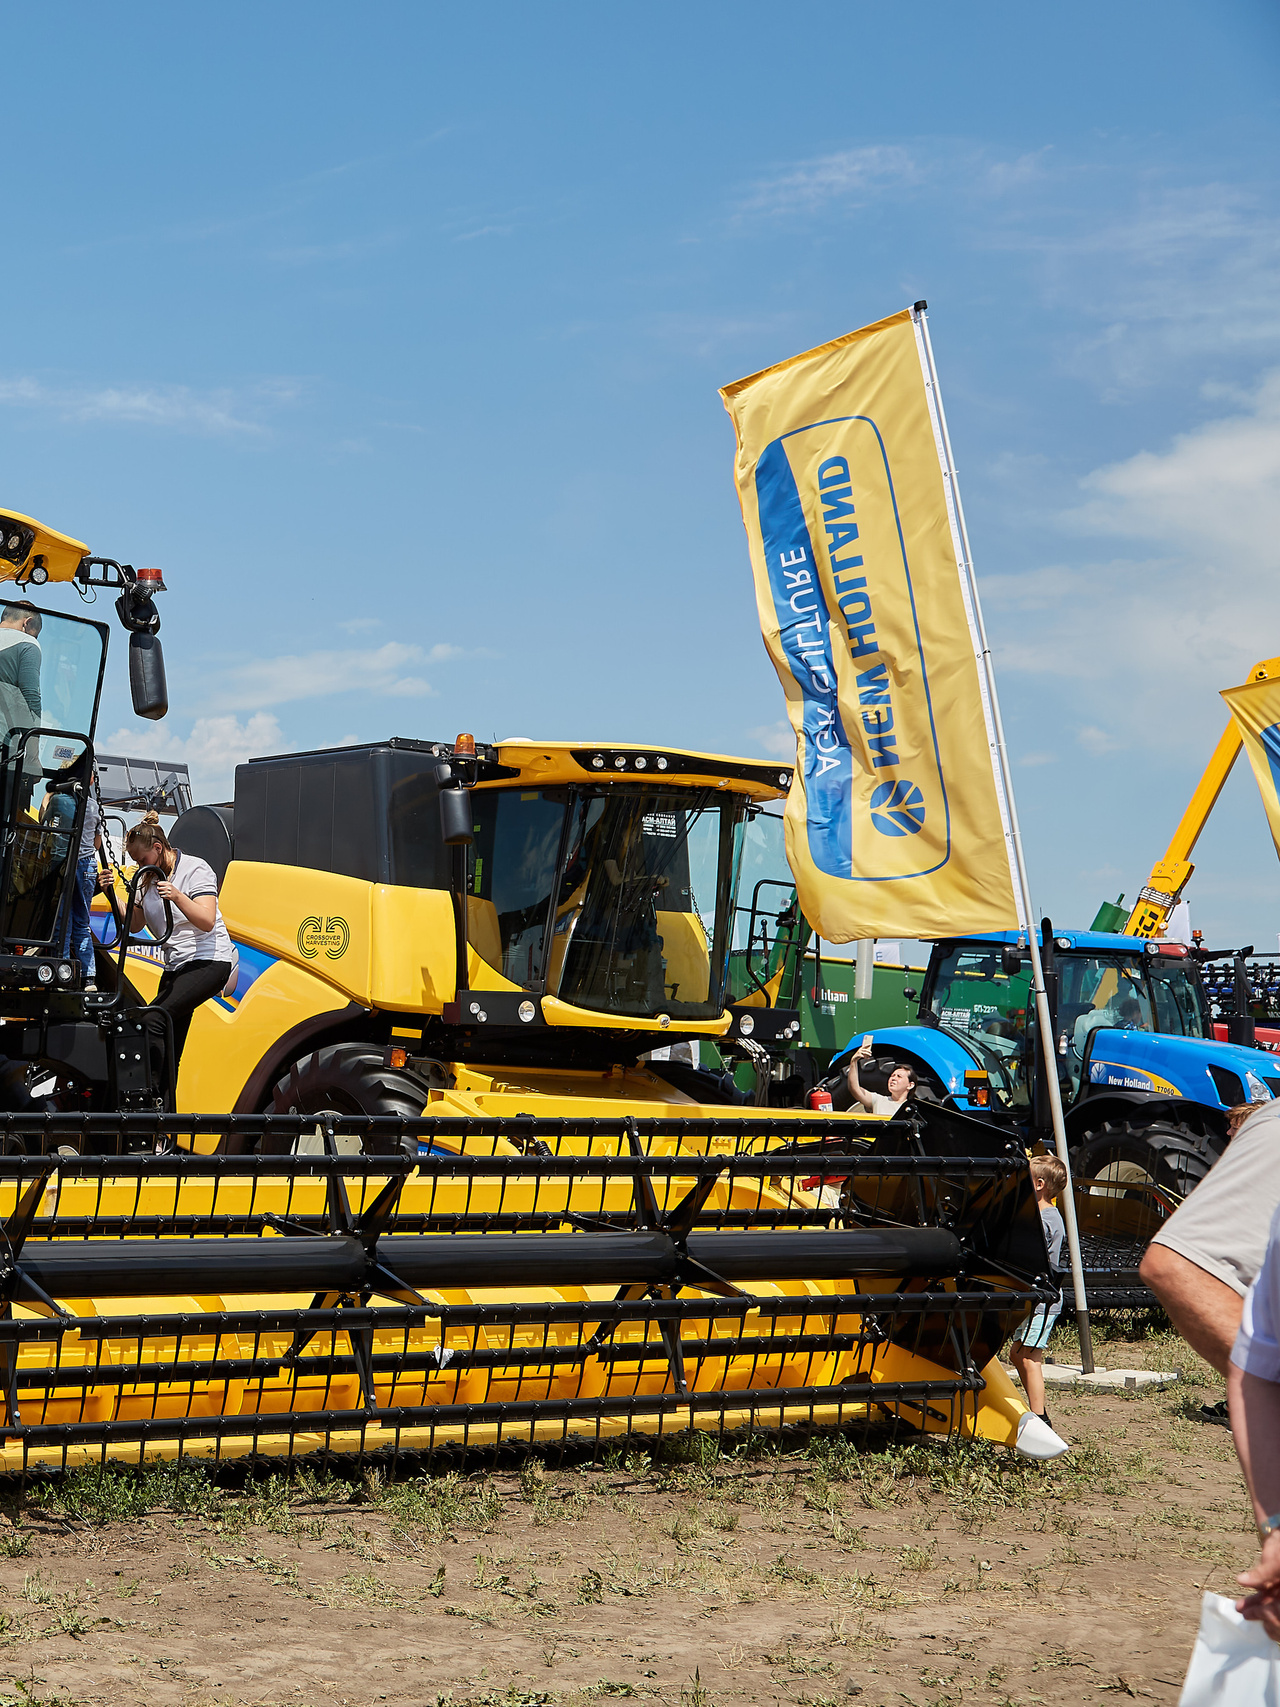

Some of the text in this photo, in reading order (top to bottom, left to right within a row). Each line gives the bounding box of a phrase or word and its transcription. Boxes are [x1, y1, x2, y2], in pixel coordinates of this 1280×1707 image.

[1108, 1075, 1151, 1090] New Holland
[1157, 1086, 1175, 1096] T7060
